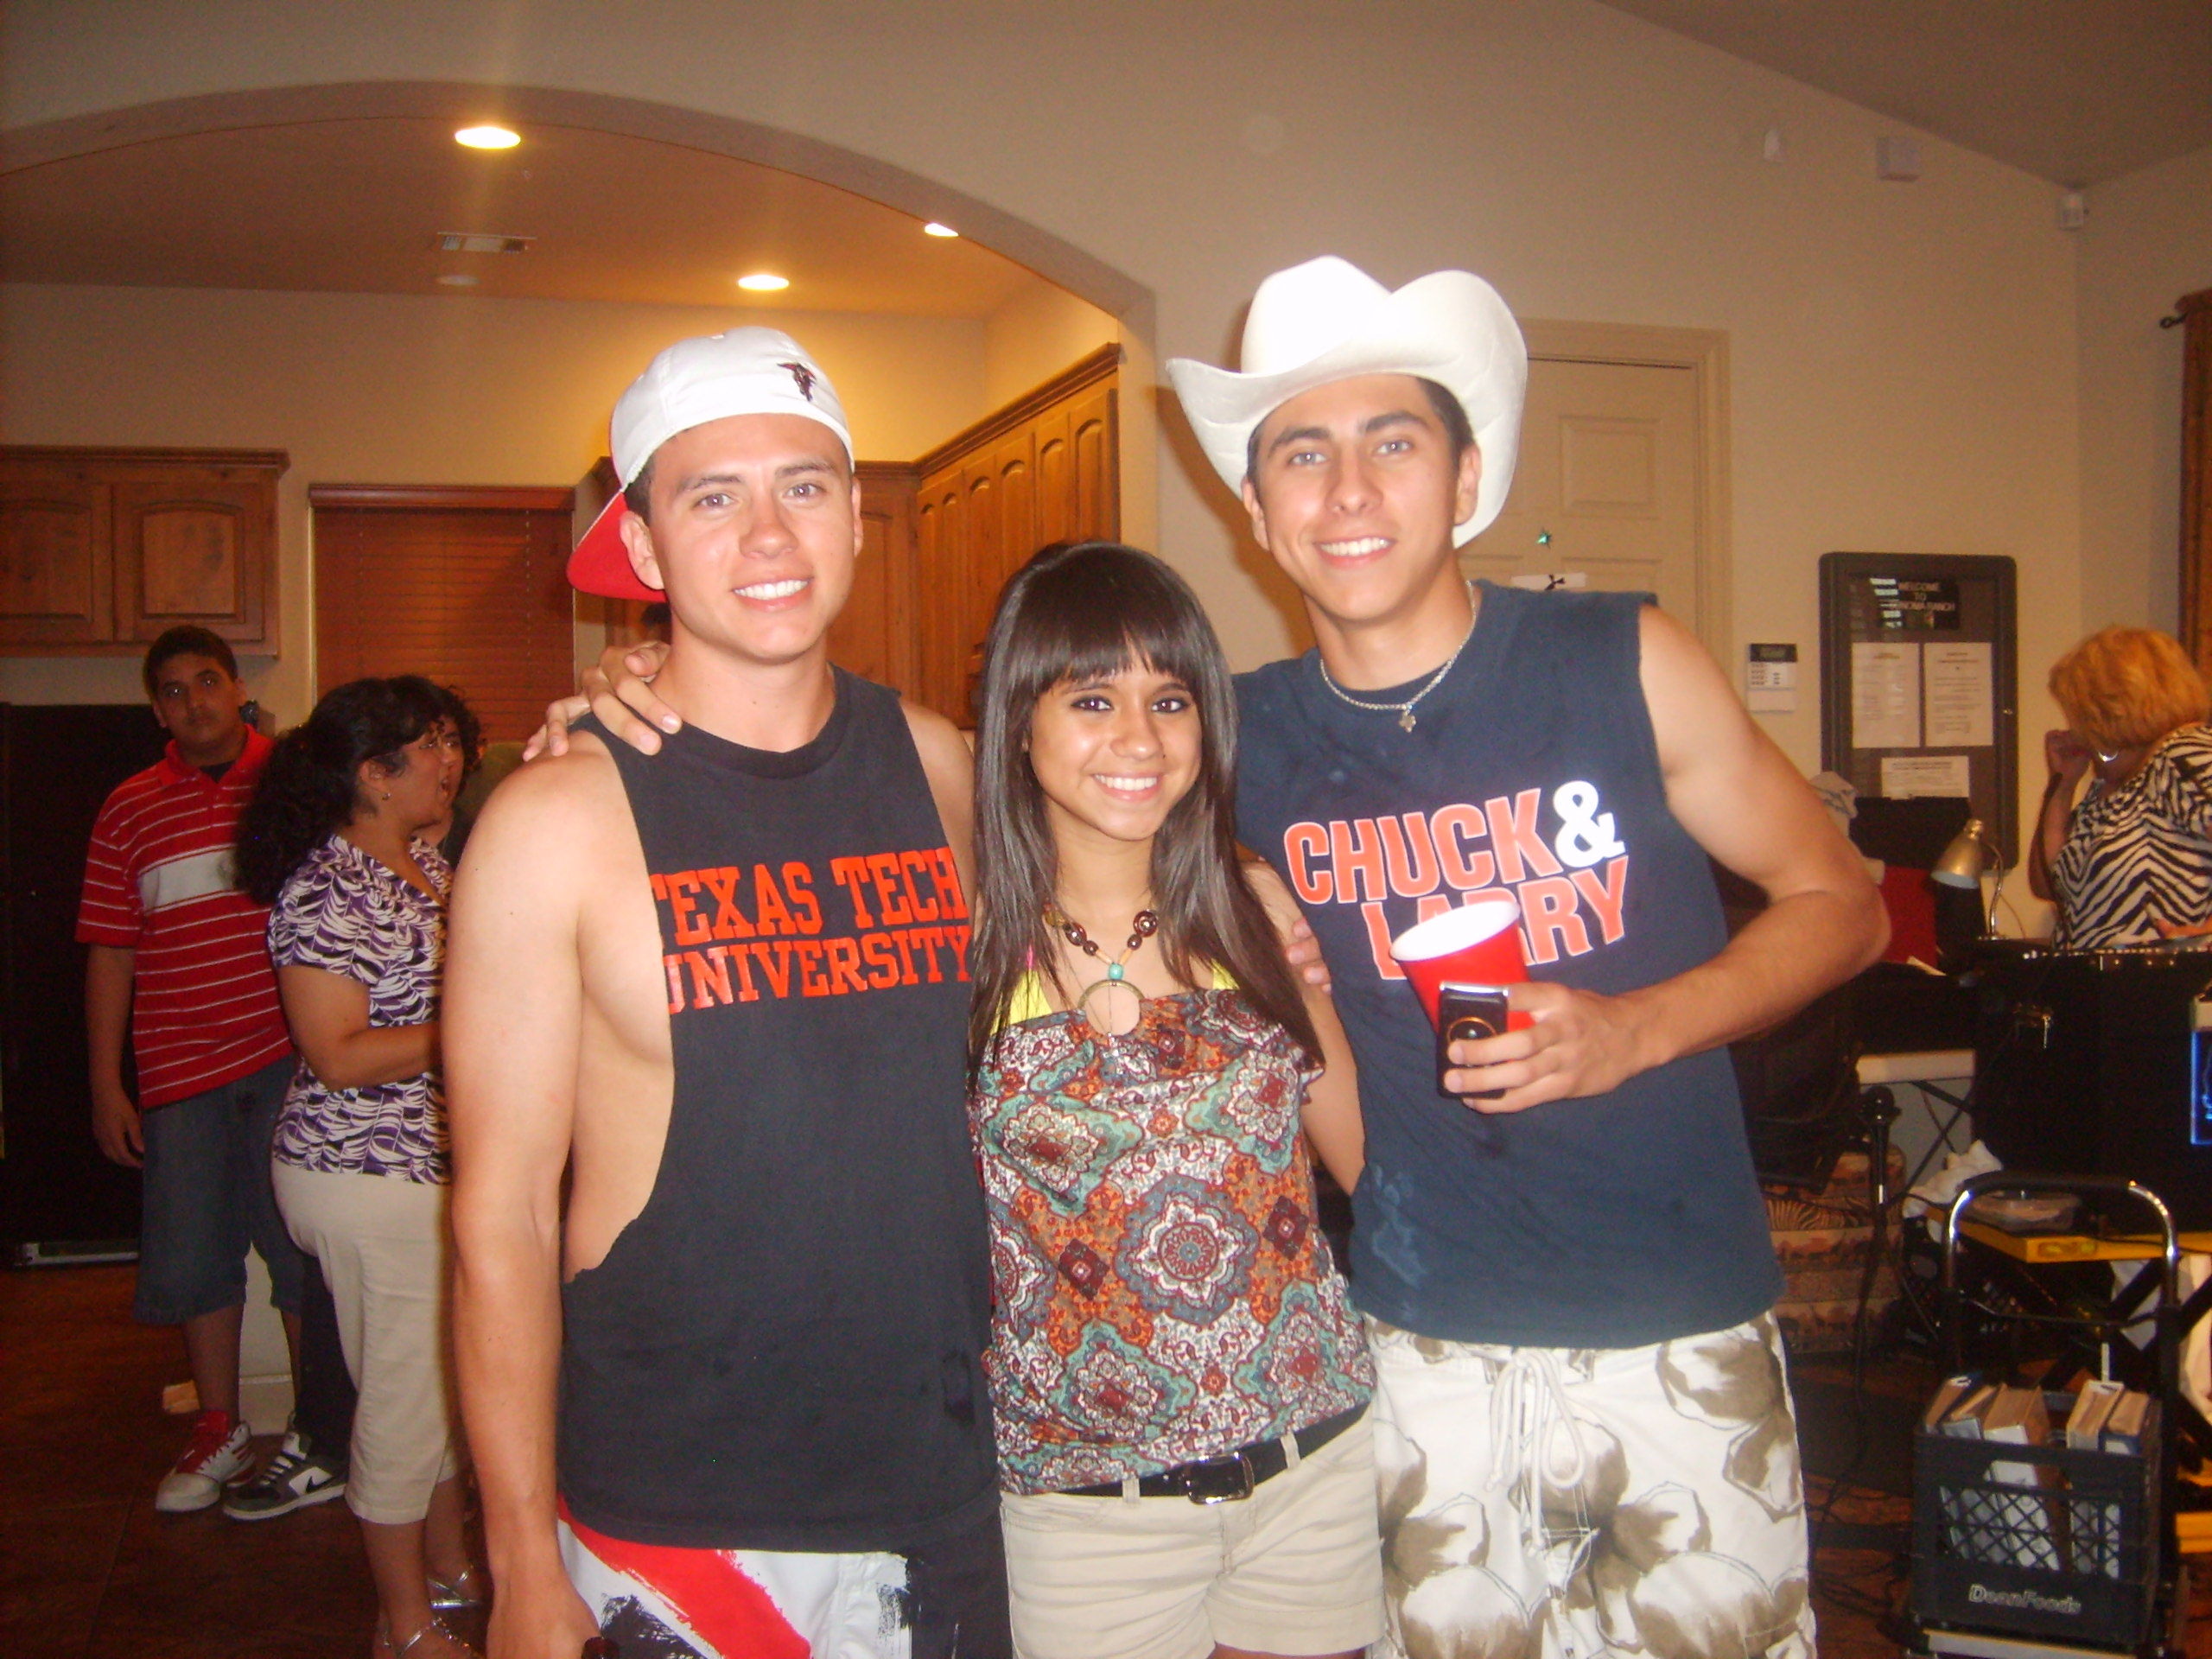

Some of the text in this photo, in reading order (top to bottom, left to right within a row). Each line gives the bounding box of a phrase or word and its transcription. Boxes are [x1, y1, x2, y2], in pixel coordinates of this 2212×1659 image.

[830, 846, 969, 929] TECH
[1284, 788, 1564, 905] CHUCK
[1361, 855, 1629, 981] LRY
